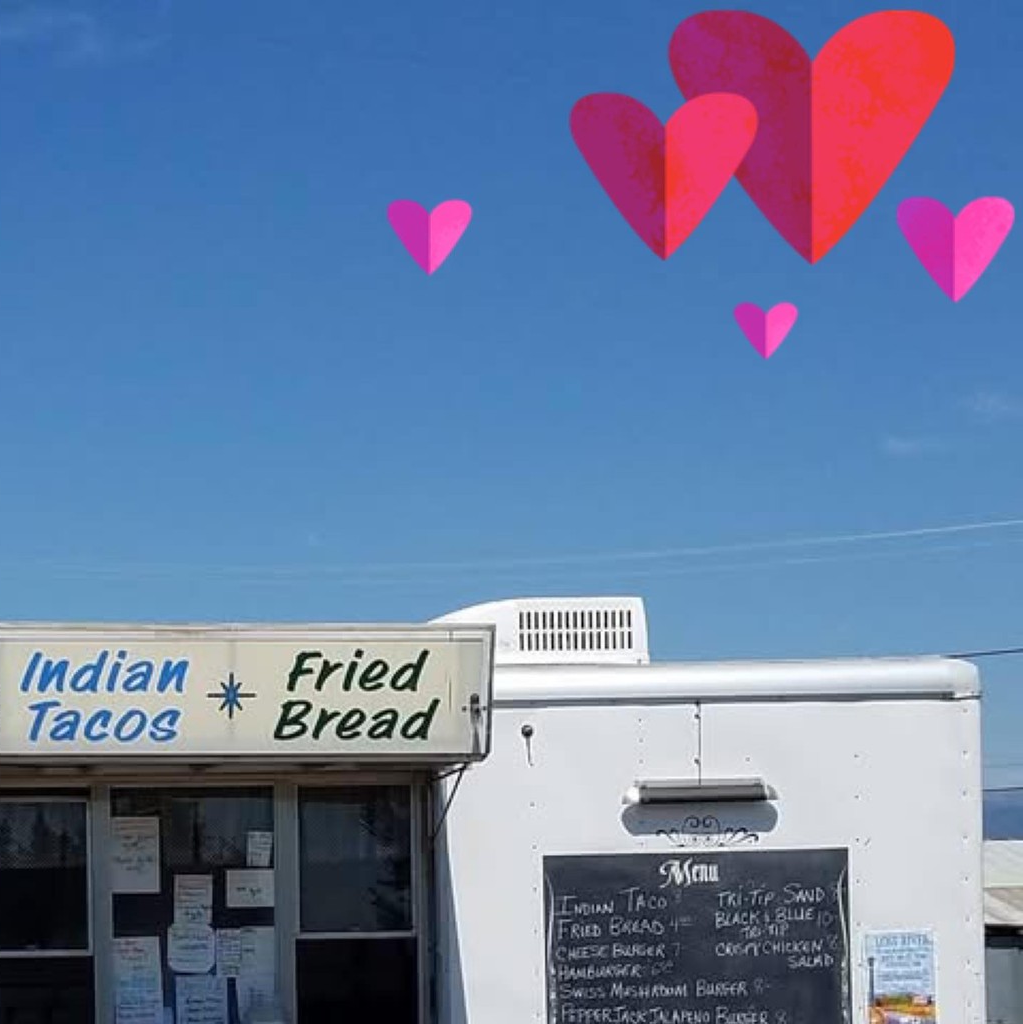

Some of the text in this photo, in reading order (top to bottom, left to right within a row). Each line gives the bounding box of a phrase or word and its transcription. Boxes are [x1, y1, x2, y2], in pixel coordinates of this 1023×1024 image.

[19, 648, 431, 693] Indian Fried
[26, 698, 441, 743] Tacos Bread
[658, 857, 719, 888] Menu
[555, 894, 615, 917] INDIAN
[617, 886, 667, 912] TACO
[783, 882, 826, 904] SAND
[556, 919, 602, 940] FRIED
[609, 915, 666, 937] BREAD
[715, 907, 761, 929] BLACK
[774, 906, 817, 922] BLUE
[762, 937, 824, 955] CHICKEN
[696, 977, 750, 998] BURGER
